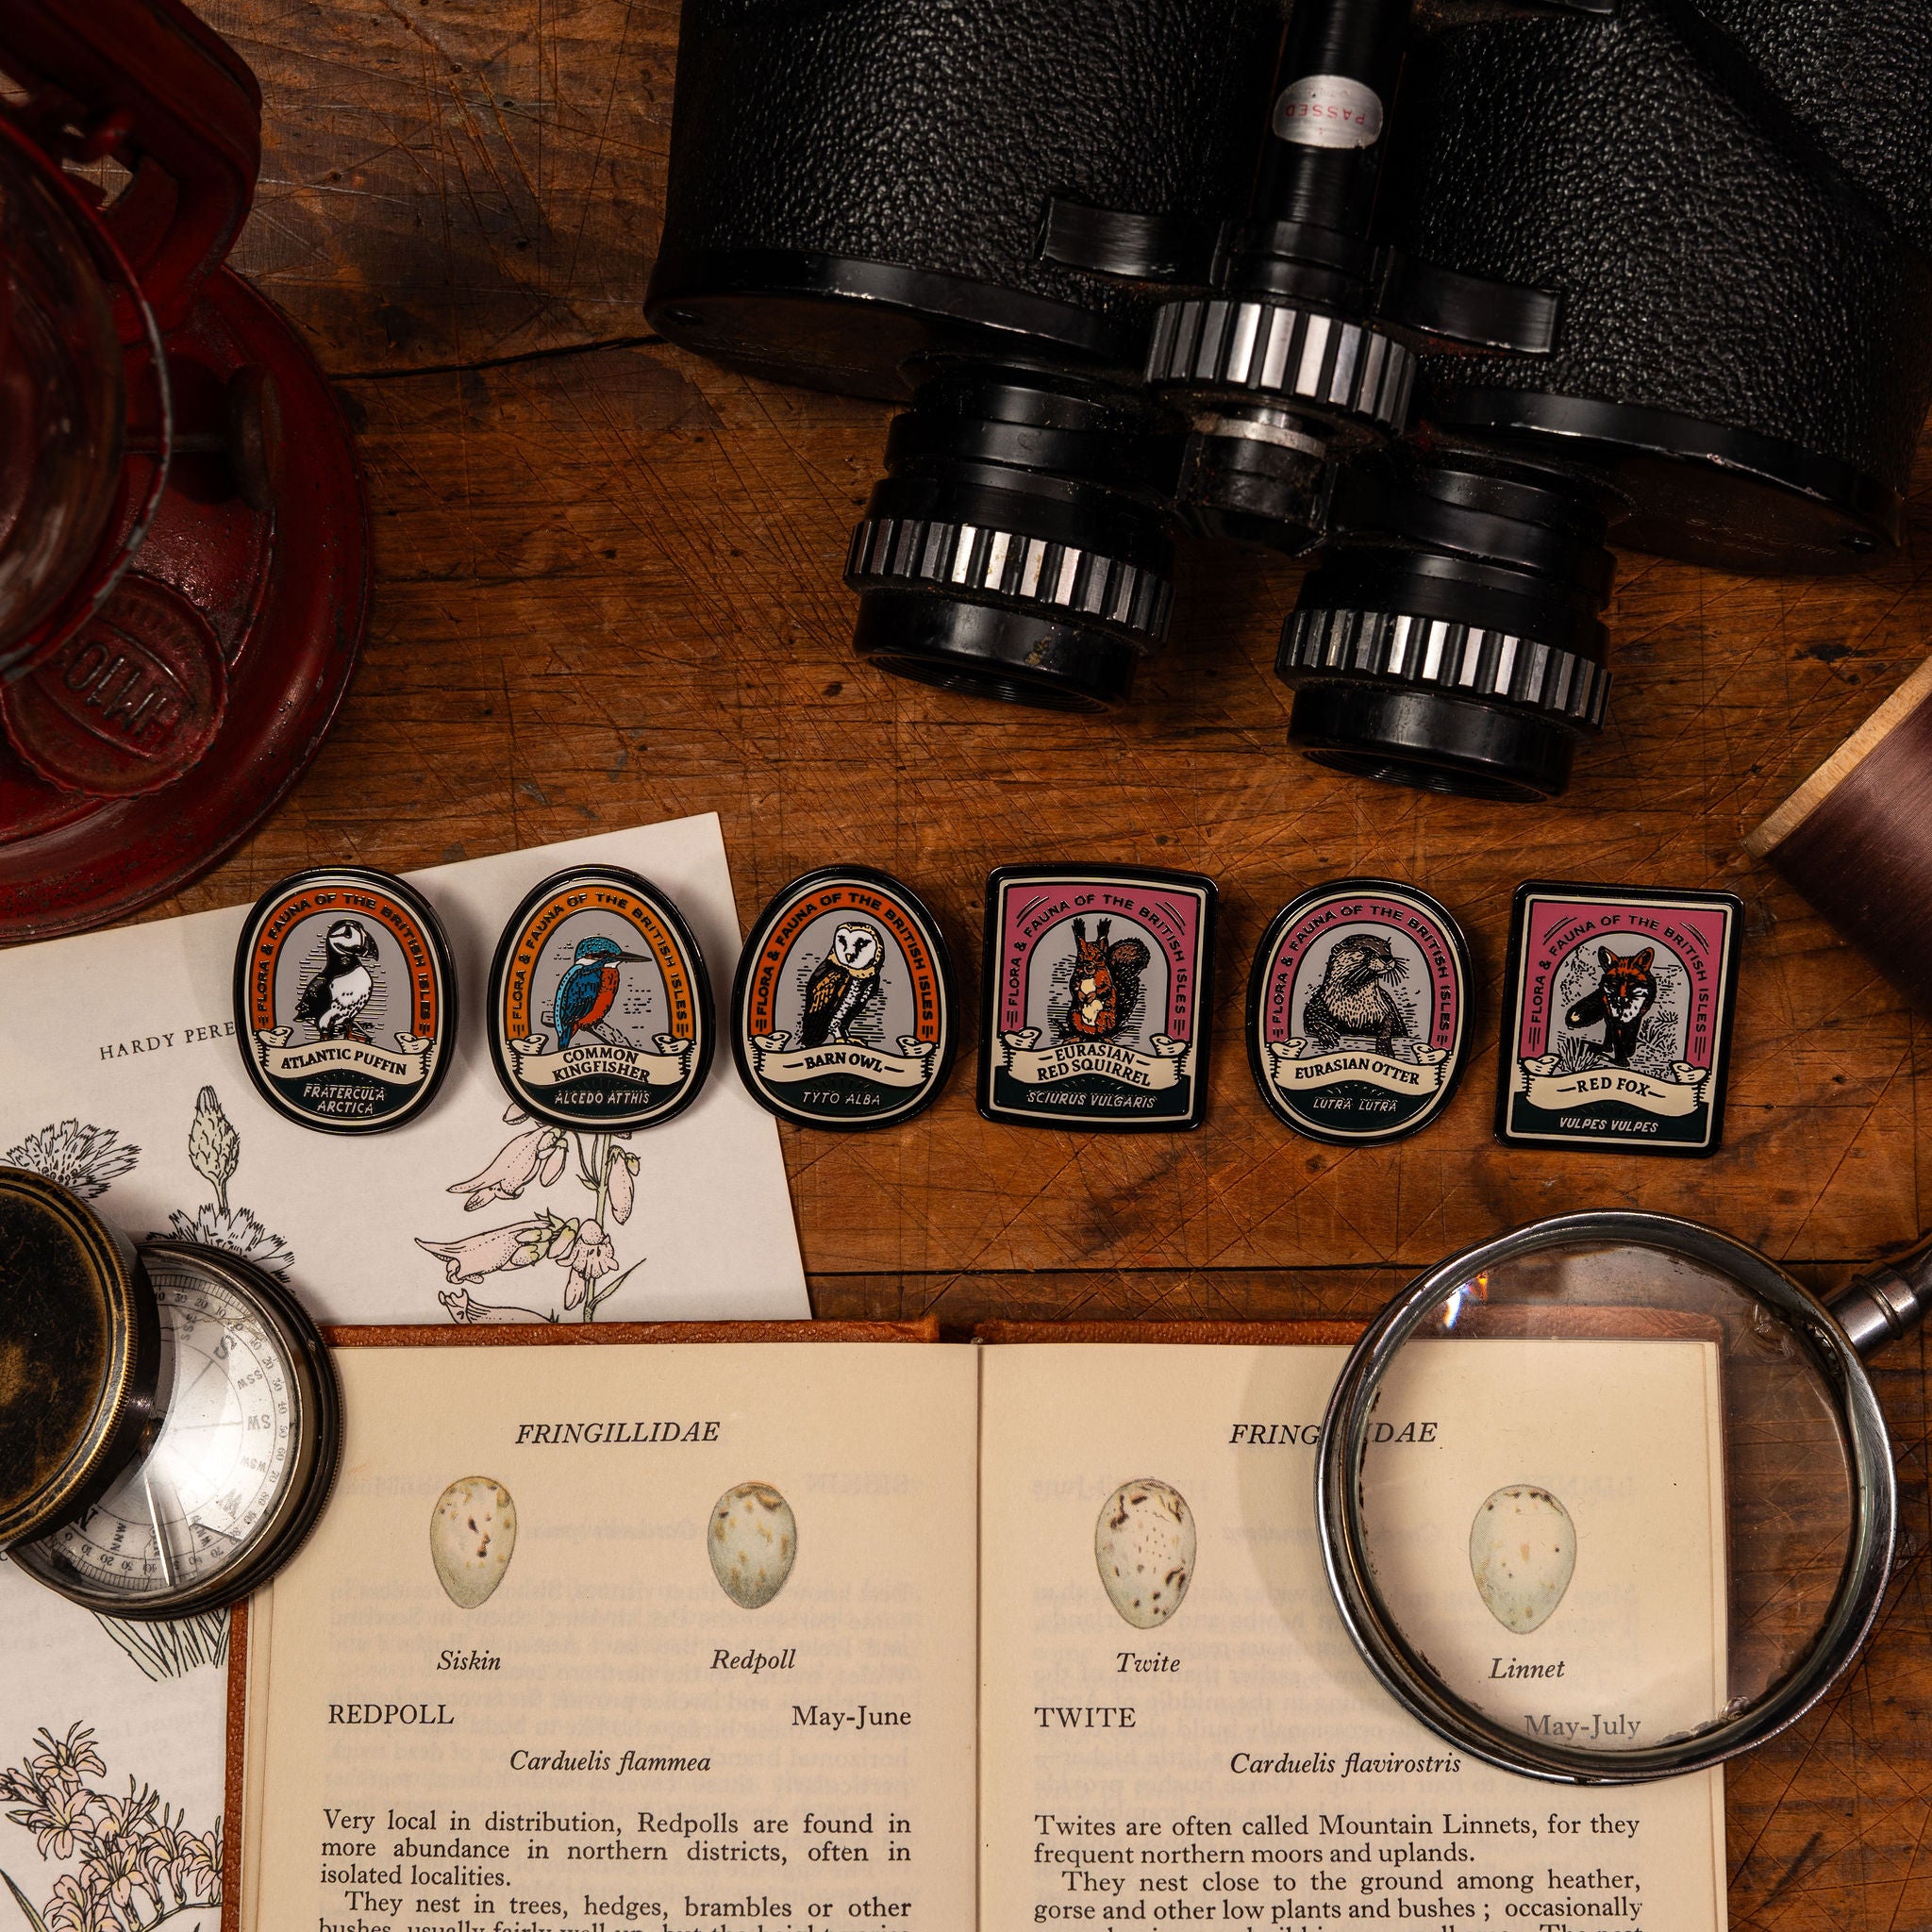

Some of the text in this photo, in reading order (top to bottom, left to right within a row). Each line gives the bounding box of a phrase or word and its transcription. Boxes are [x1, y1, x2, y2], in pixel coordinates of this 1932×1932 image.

[1285, 104, 1366, 125] PASSED
[314, 893, 337, 906] OF
[342, 893, 376, 909] THE
[270, 898, 310, 940] FAUNA
[260, 943, 274, 957] &
[513, 892, 688, 1020] FLORA & FAUNA OF THE BRITISH ISLES
[758, 892, 933, 1020] FLORA & FAUNA OF THE BRITISH ISLES
[1008, 894, 1188, 1014] FLORA & FAUNA OF THE BRITISH ISLES
[1274, 905, 1451, 1031] FLORA & FAUNA OF THE BRITISH ISLES
[1532, 914, 1709, 1033] FLORA & FAUNA OF THE BRITISH ISLES
[258, 958, 271, 1012] FLORA
[99, 1033, 175, 1060] HARDY
[563, 1048, 640, 1063] COMMON
[1056, 1043, 1135, 1064] EURASIAN
[281, 1049, 407, 1075] ATLANTIC PUFFIN
[552, 1060, 652, 1083] KINGFISHER
[805, 1052, 884, 1073] BARN OWL
[1037, 1059, 1151, 1087] RED SQUIRREL
[1295, 1058, 1420, 1085] EURASIAN OTTER
[303, 1084, 386, 1101] FRATERCULA
[555, 1090, 652, 1105] ALCEDO ATTHIS
[803, 1091, 881, 1105] TYTO ALBA
[1576, 1077, 1651, 1097] RED FOX
[317, 1100, 374, 1114] ARCTICA
[1027, 1091, 1157, 1108] SCIURUS VULGARIS
[1313, 1097, 1398, 1112] LUTRA LUTRA
[1559, 1117, 1658, 1133] VULPES VULPES
[194, 1299, 208, 1308] 20
[215, 1307, 226, 1317] 10
[213, 1336, 237, 1359] S
[262, 1357, 274, 1370] 20
[237, 1370, 262, 1390] SSW
[247, 1415, 270, 1430] SW
[515, 1422, 720, 1443] FRINGILLIDAE
[1228, 1422, 1439, 1445] FRINGDAE
[110, 1522, 126, 1551] NNW
[82, 1544, 92, 1556] 10
[100, 1555, 114, 1566] 20
[437, 1650, 501, 1670] Siskin
[710, 1649, 795, 1674] Redpoll
[1117, 1653, 1180, 1673] Twite
[1490, 1657, 1565, 1679] Linnet
[329, 1705, 911, 1730] REDPOLL May-June
[1035, 1707, 1641, 1743] TWITE May-July
[510, 1750, 710, 1775] Carduelis flammea
[1231, 1752, 1460, 1777] Carduelis flavirostris
[324, 1809, 910, 1838] Very local in distribution, Redpolls are found in
[1035, 1813, 1640, 1838] Twites are often called Mountain Linnets, for they
[322, 1838, 910, 1864] more abundance in northern districts, often in
[1035, 1841, 1474, 1868] frequent northern moors and uplands.
[321, 1864, 510, 1886] isolated localities.
[1062, 1869, 1640, 1896] They nest close to the ground among heather,
[345, 1891, 911, 1920] They nest in trees, hedges, brambles or other
[1035, 1904, 1094, 1924] gorse
[1104, 1900, 1145, 1920] and
[1154, 1899, 1216, 1920] other
[1224, 1899, 1264, 1919] low
[1272, 1899, 1341, 1924] plants
[1349, 1898, 1391, 1919] and
[1398, 1897, 1474, 1919] bushes
[1506, 1896, 1641, 1923] occasionally
